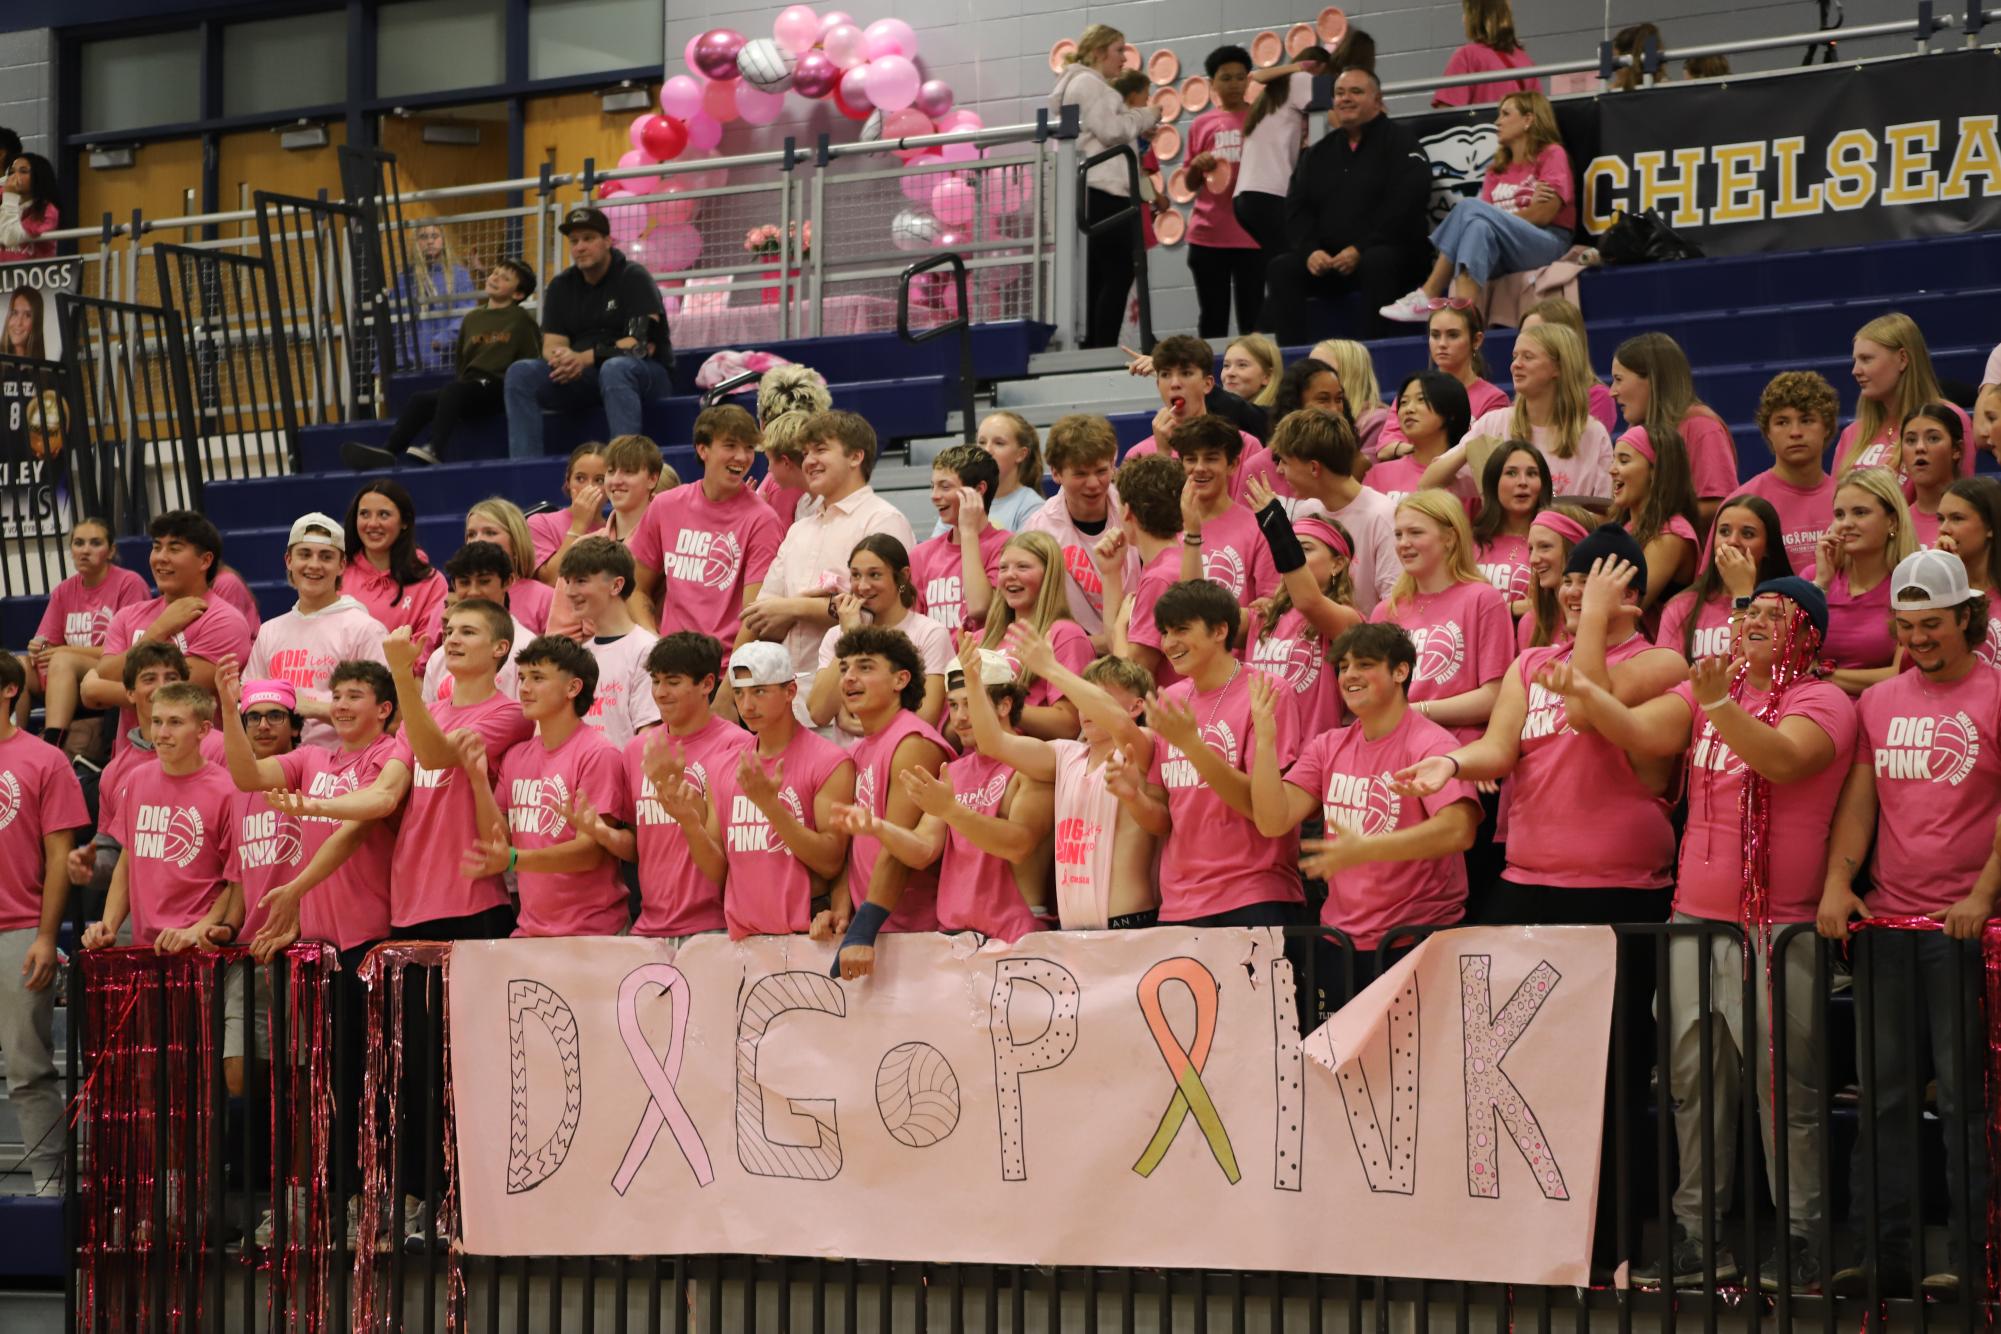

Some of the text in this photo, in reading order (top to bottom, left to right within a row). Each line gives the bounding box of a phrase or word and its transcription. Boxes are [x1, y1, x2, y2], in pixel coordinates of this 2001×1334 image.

[1583, 114, 2001, 236] CHELSEA
[0, 263, 71, 293] LDOGS
[10, 401, 20, 430] 8
[1856, 444, 1885, 465] IG
[675, 528, 712, 557] DIG
[1782, 533, 1794, 546] IG
[664, 551, 708, 583] PINK
[926, 575, 961, 605] DIG
[66, 611, 92, 634] DIG
[927, 602, 962, 628] INK
[1691, 626, 1731, 658] DIG
[284, 649, 308, 667] DIG
[1520, 707, 1557, 740] INK
[1886, 716, 1935, 748] DIG
[1949, 710, 1980, 786] CHELSEA VS DEXTER
[414, 761, 443, 789] INK
[1875, 748, 1933, 780] PINK
[512, 778, 542, 807] DIG
[1326, 772, 1370, 809] DIG
[136, 804, 171, 833] DIG
[242, 810, 276, 842] DIG
[238, 838, 278, 870] PINK
[727, 825, 770, 853] PINK
